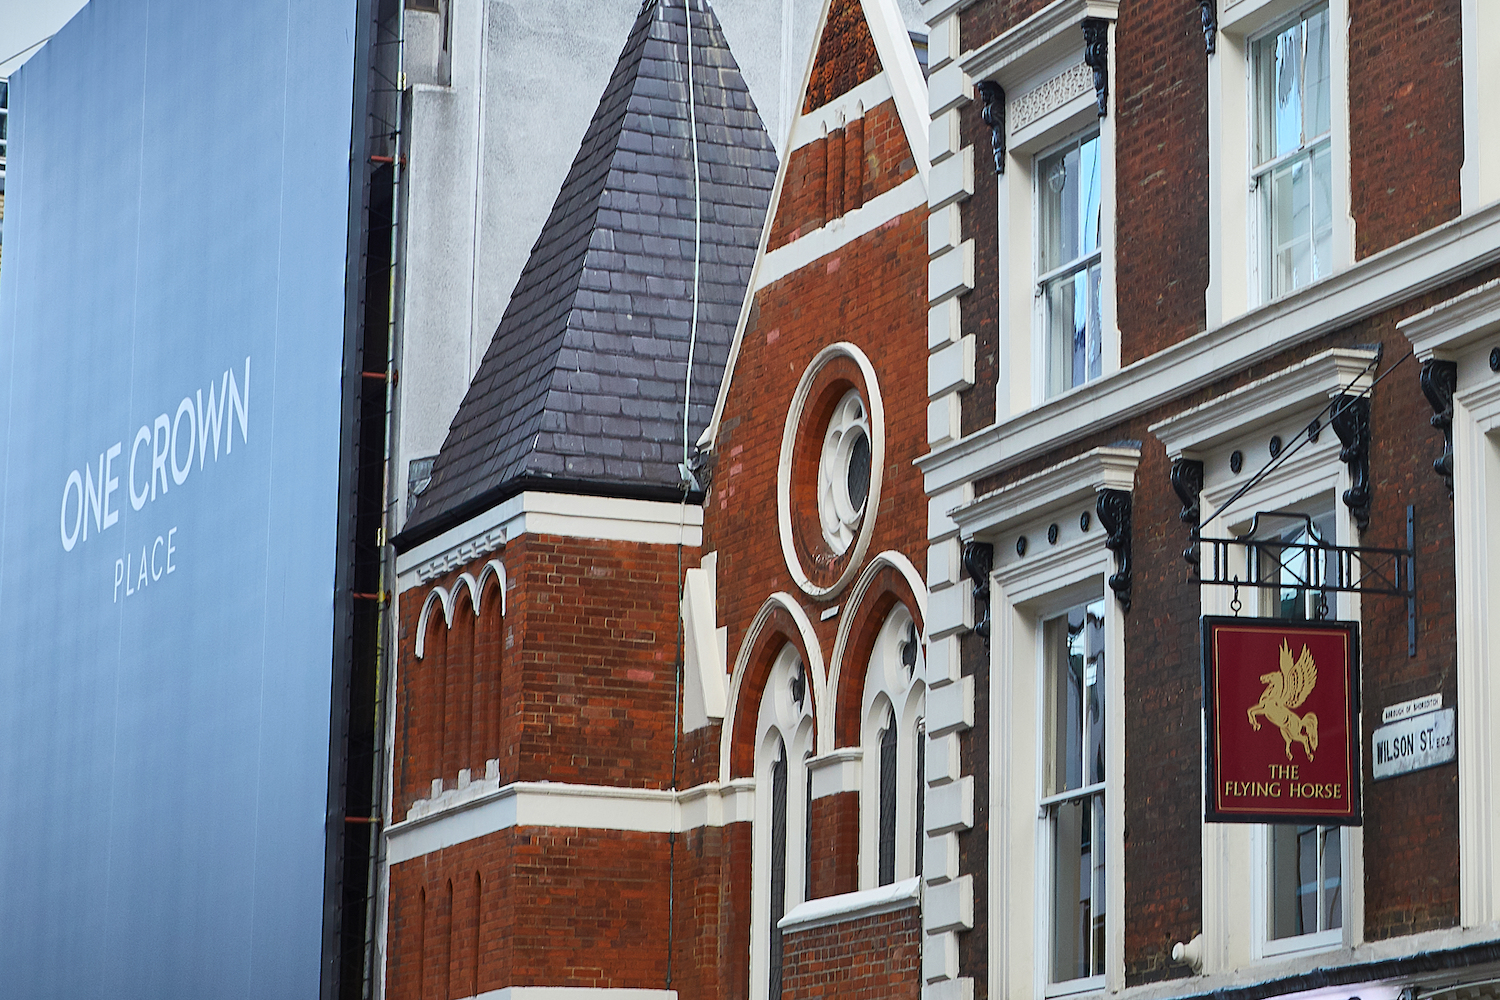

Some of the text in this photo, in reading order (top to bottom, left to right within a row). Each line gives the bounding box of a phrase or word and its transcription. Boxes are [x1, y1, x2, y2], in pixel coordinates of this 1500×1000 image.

[60, 355, 251, 553] ONE CROWN
[113, 526, 178, 603] PLACE
[1376, 732, 1414, 765] WILSON
[1268, 763, 1300, 780] THE
[1224, 780, 1343, 800] FLYING HORSE
